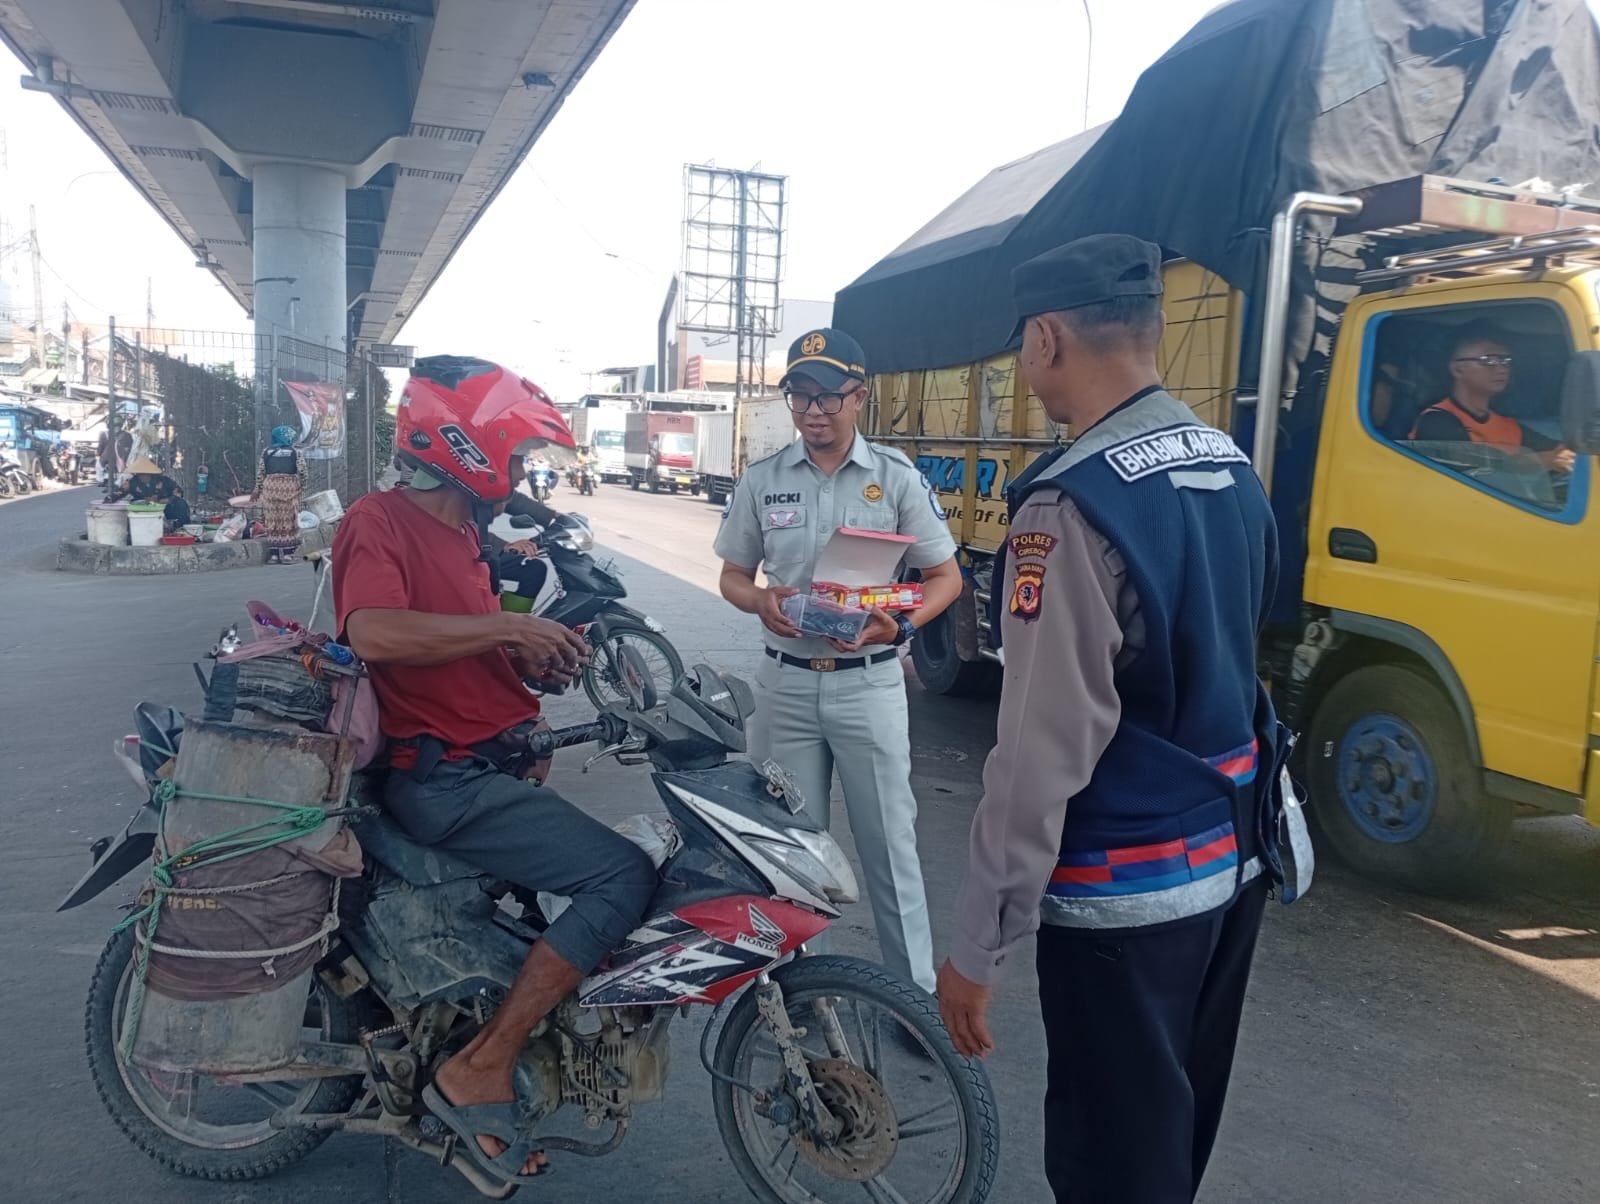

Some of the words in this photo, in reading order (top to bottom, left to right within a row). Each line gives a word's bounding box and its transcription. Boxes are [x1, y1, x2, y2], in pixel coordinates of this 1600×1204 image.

[764, 492, 801, 506] DICKI
[942, 506, 964, 521] yle
[975, 509, 994, 523] Of
[998, 512, 1008, 526] G
[1012, 533, 1053, 548] POLRES
[738, 934, 780, 953] HONDA
